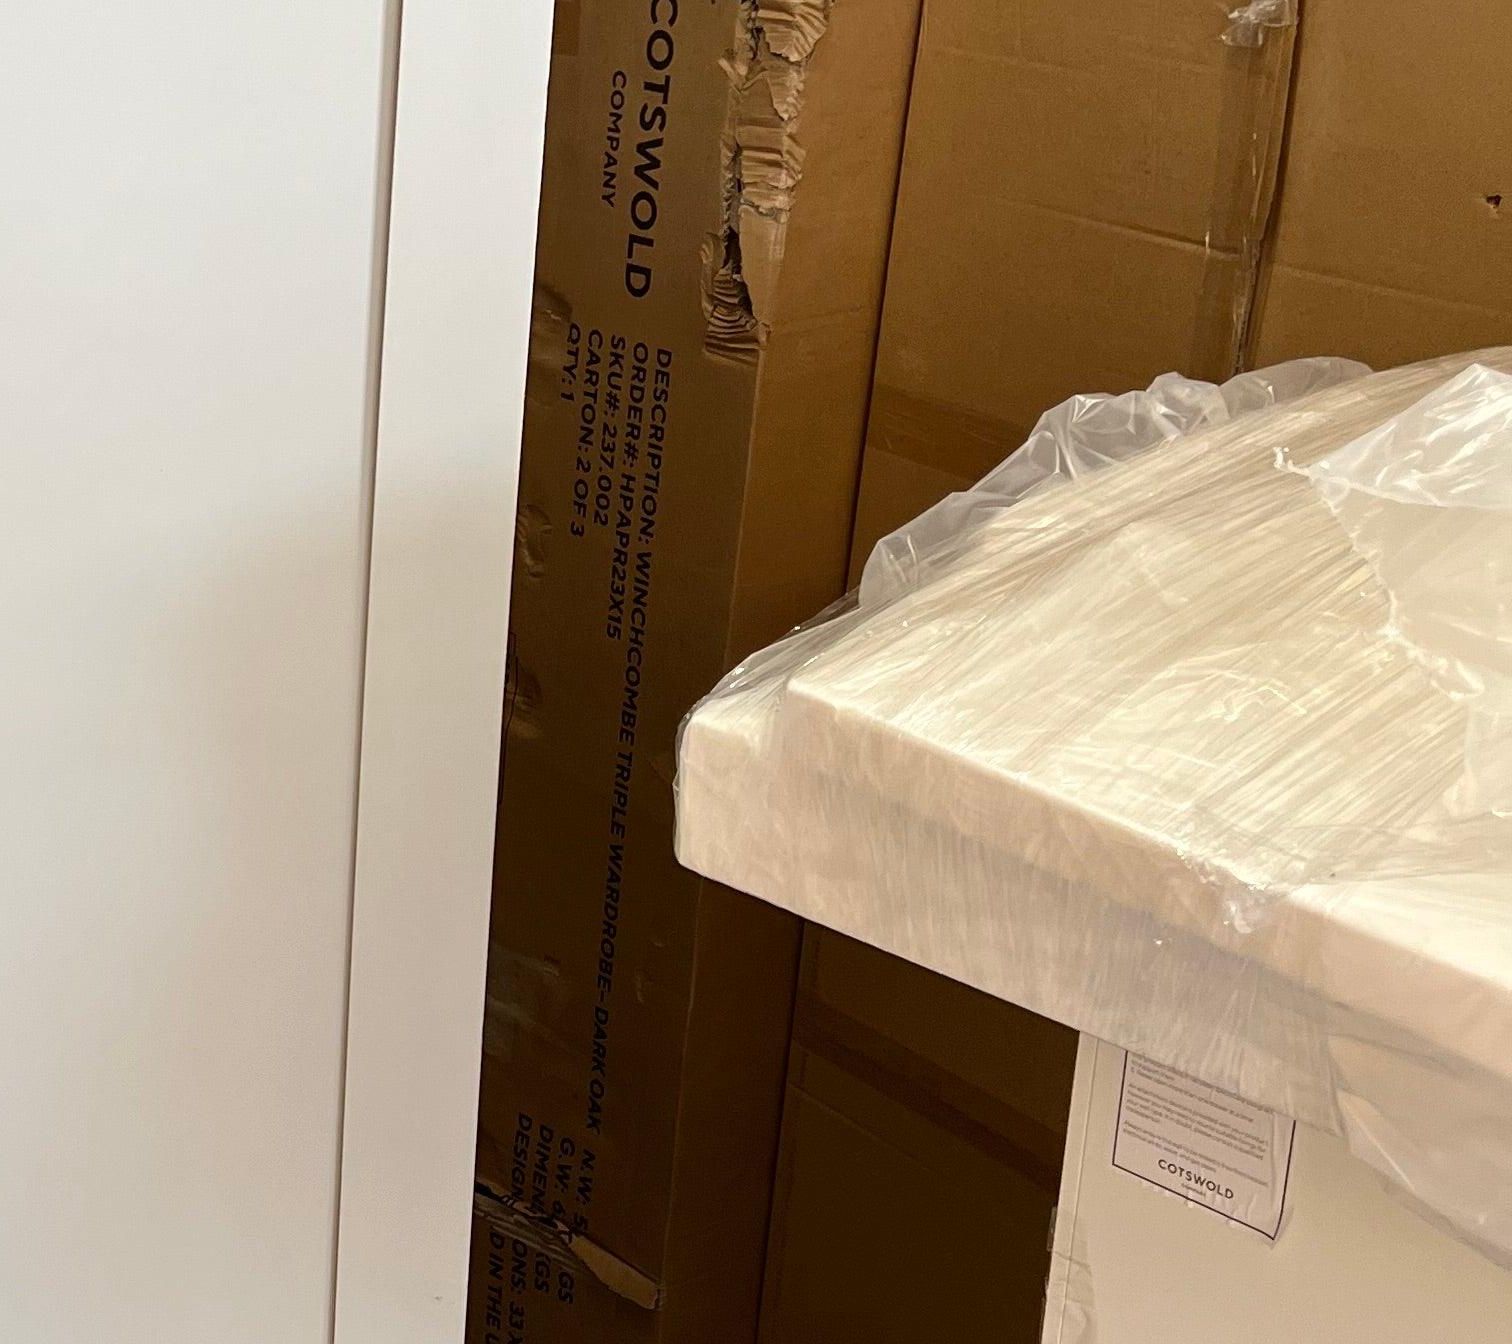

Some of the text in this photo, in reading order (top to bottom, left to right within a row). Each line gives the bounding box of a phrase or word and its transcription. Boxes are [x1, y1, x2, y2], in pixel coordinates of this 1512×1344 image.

[601, 70, 627, 208] COMPANY
[570, 329, 604, 538] CARTON: 2 OF 3
[593, 334, 626, 527] SKU#: 237.002
[639, 348, 672, 544] DESCRIPTION:
[606, 342, 649, 641] ORDER#: HPAPR23X15
[618, 552, 652, 747] WINCHCOMBE
[609, 751, 633, 839] TRIPLE
[591, 1006, 609, 1076] DARK
[586, 1078, 606, 1136] OAK
[1157, 1158, 1235, 1200] COTSWOLD
[486, 1286, 503, 1331] THE
[489, 1256, 504, 1281] IN
[508, 1301, 525, 1330] 33
